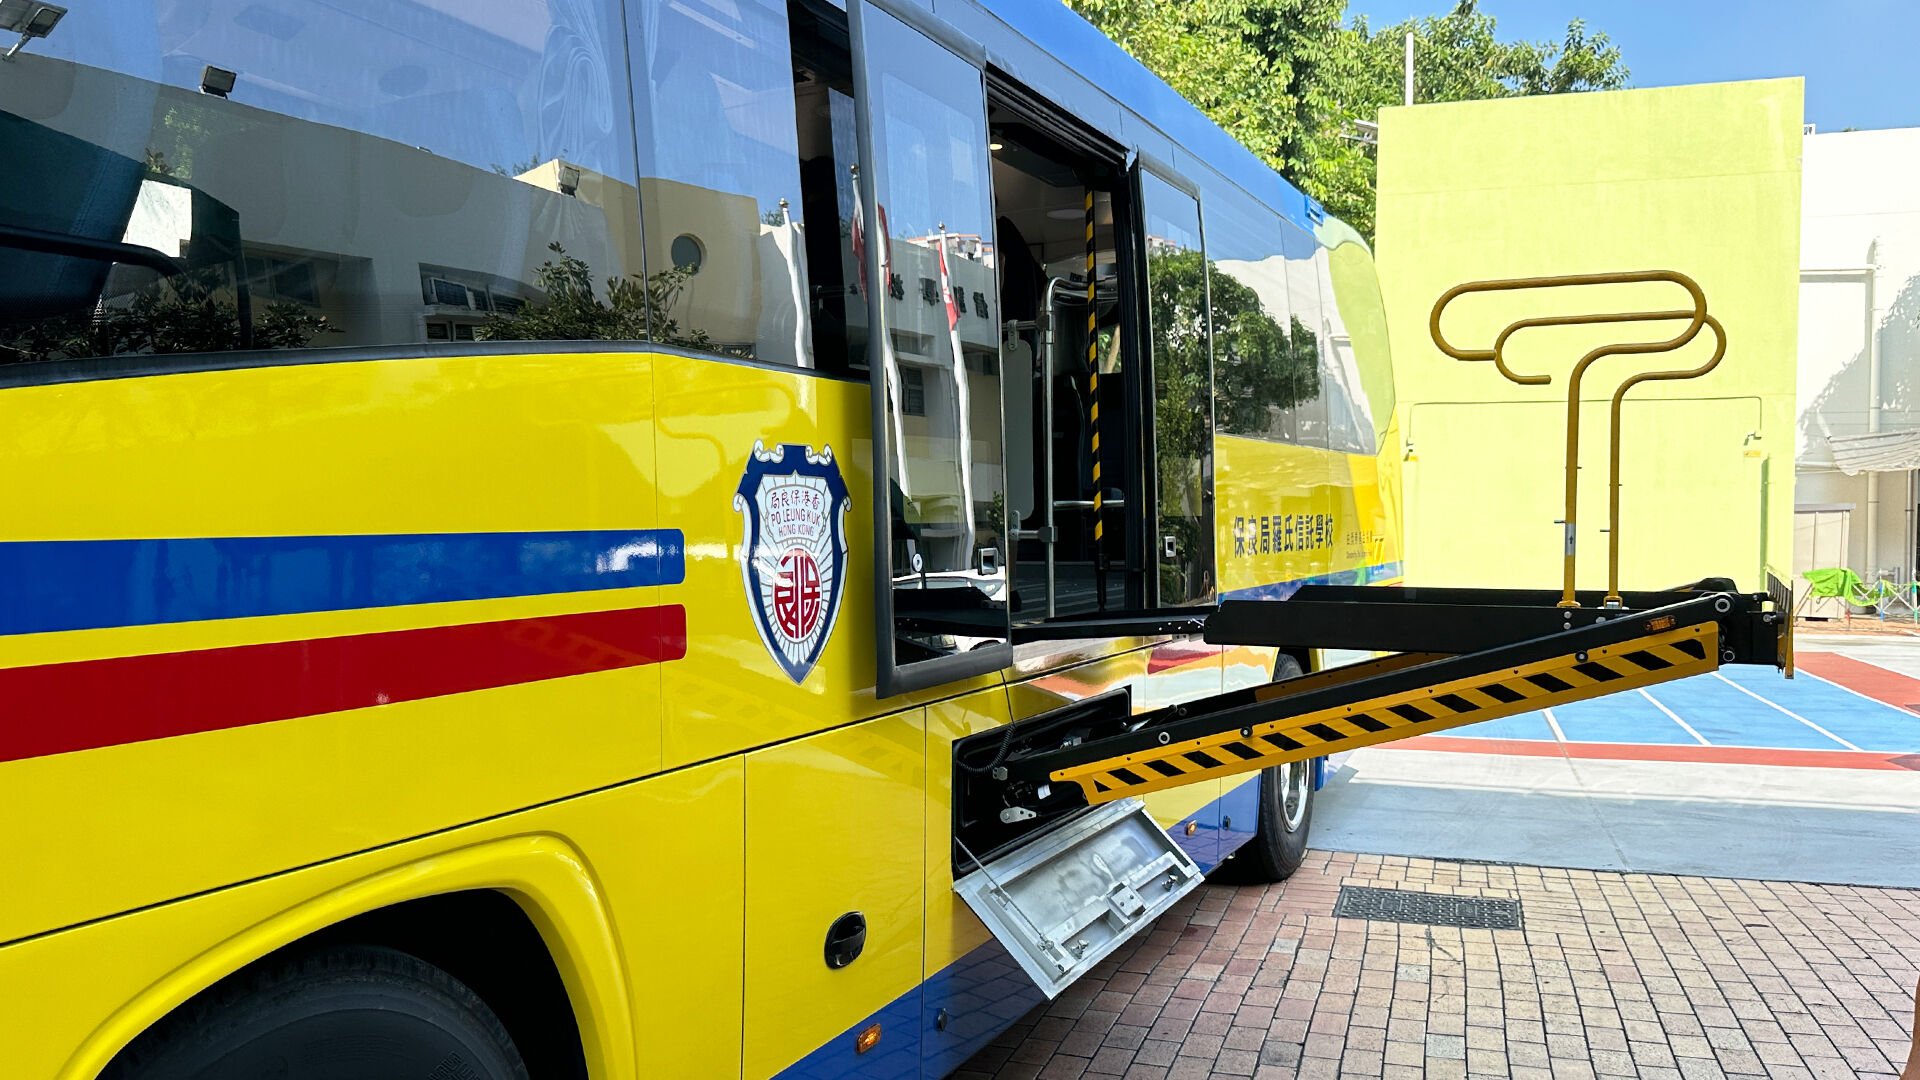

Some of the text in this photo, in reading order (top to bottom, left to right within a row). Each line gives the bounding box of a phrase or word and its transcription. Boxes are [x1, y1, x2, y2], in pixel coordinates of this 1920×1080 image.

[771, 508, 821, 527] PO LEUNG KUK
[779, 523, 814, 537] HONG KONG
